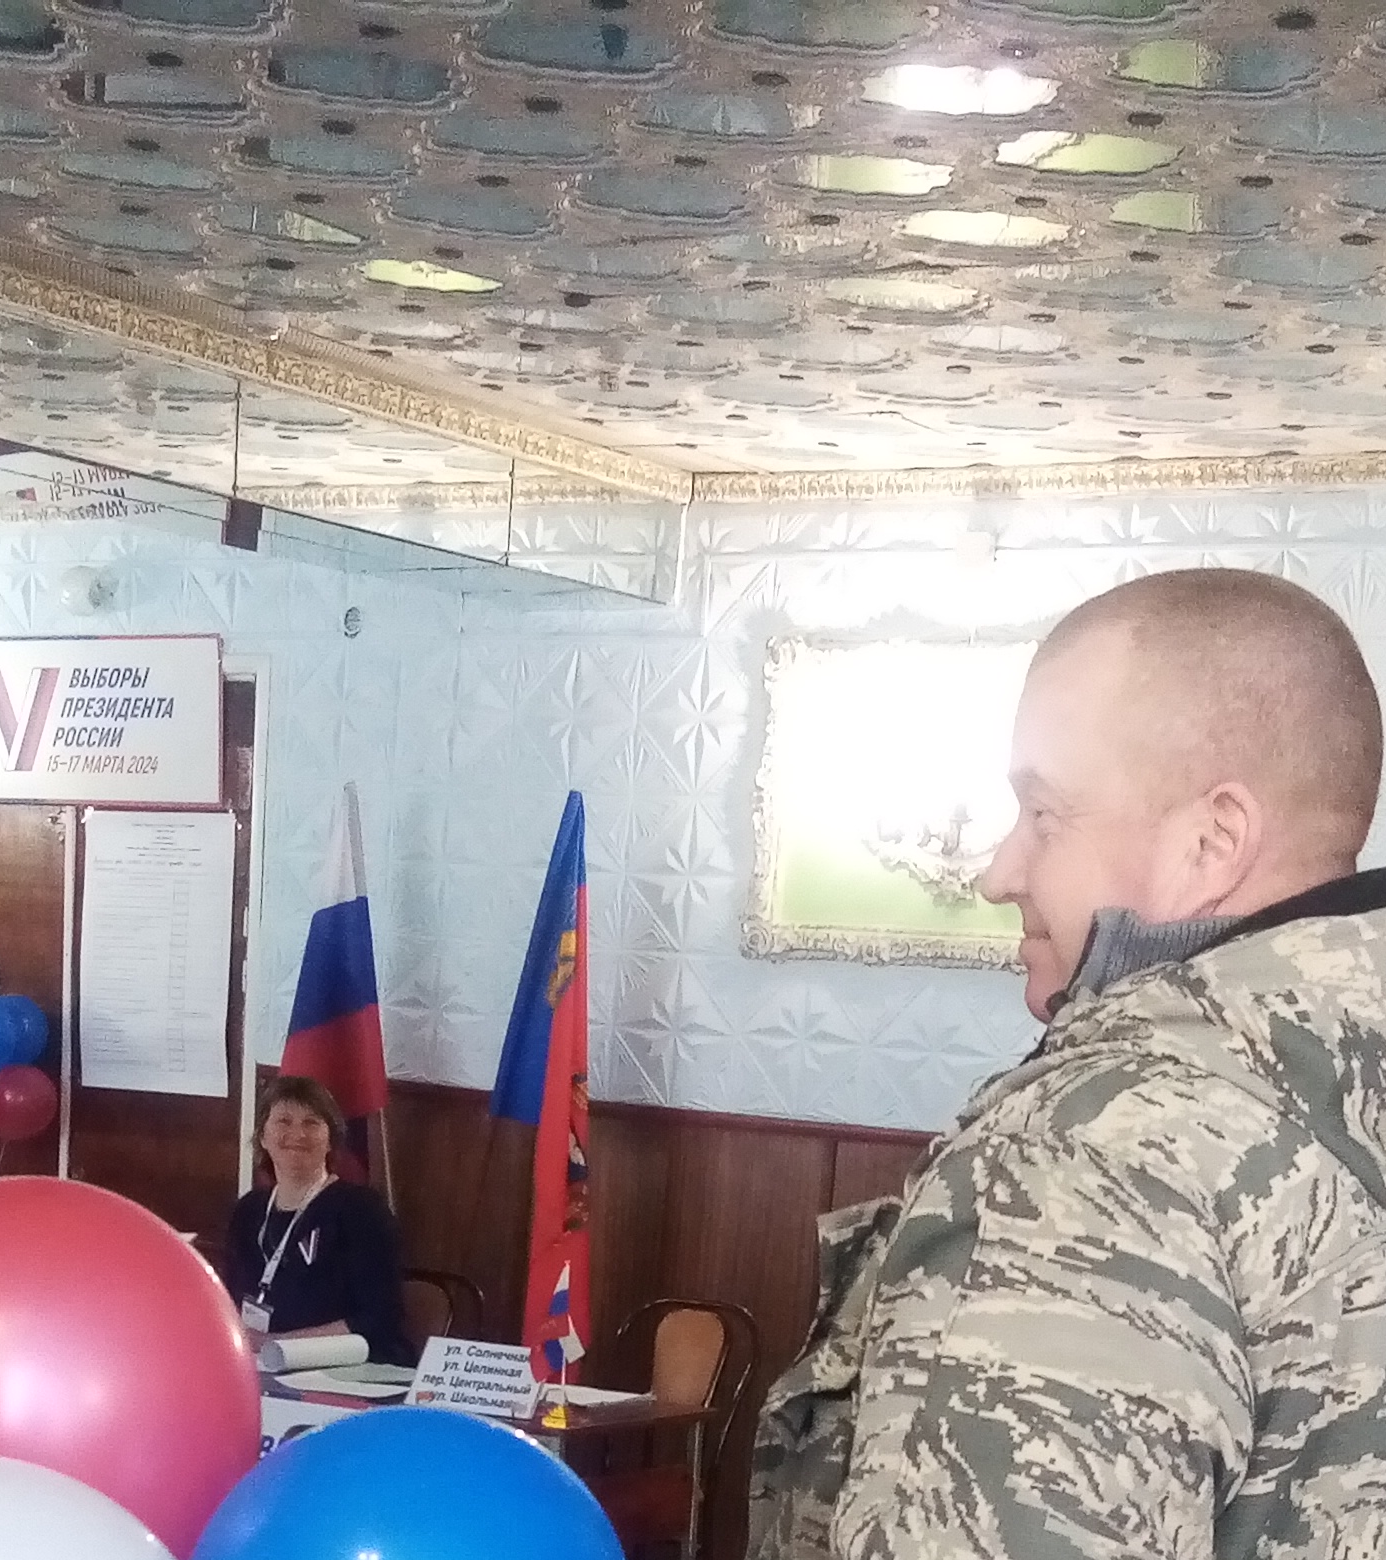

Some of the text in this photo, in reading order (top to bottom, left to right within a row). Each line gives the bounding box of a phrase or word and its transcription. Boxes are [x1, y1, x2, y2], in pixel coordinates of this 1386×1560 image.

[68, 667, 151, 689] ВЫБОРЫ
[60, 697, 175, 722] ПРЕЗИДЕНТА
[52, 727, 125, 748] РОССИИ
[82, 756, 125, 774] МАРТА
[126, 755, 159, 774] 2024
[444, 1344, 462, 1357] ул.
[442, 1360, 523, 1378] ул. Целинная
[421, 1373, 532, 1395] пер. Центральный
